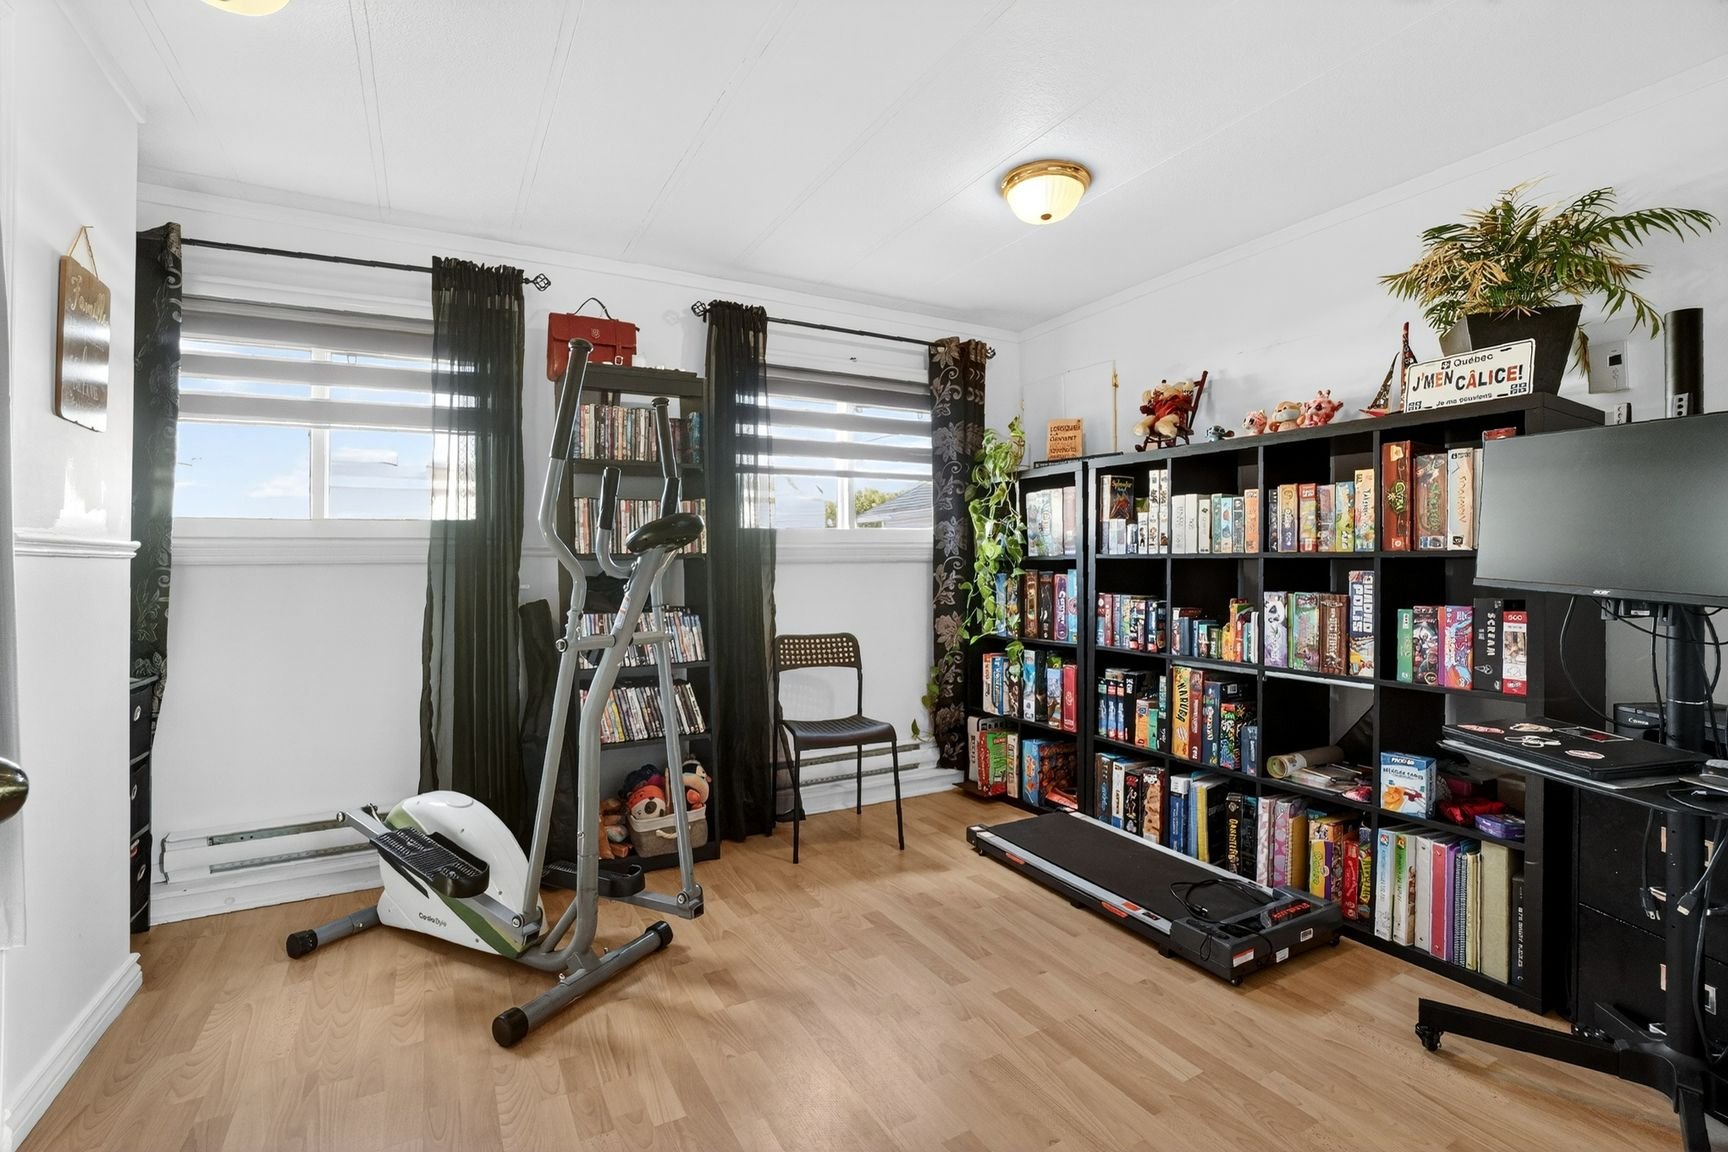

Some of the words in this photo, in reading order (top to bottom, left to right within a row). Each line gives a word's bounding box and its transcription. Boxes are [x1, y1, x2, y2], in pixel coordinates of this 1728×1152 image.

[1453, 353, 1494, 368] Québec
[1412, 370, 1454, 392] J'MEN
[1455, 364, 1524, 391] CÂLICE!
[1486, 612, 1496, 656] SCREAM
[1628, 717, 1649, 726] Canon
